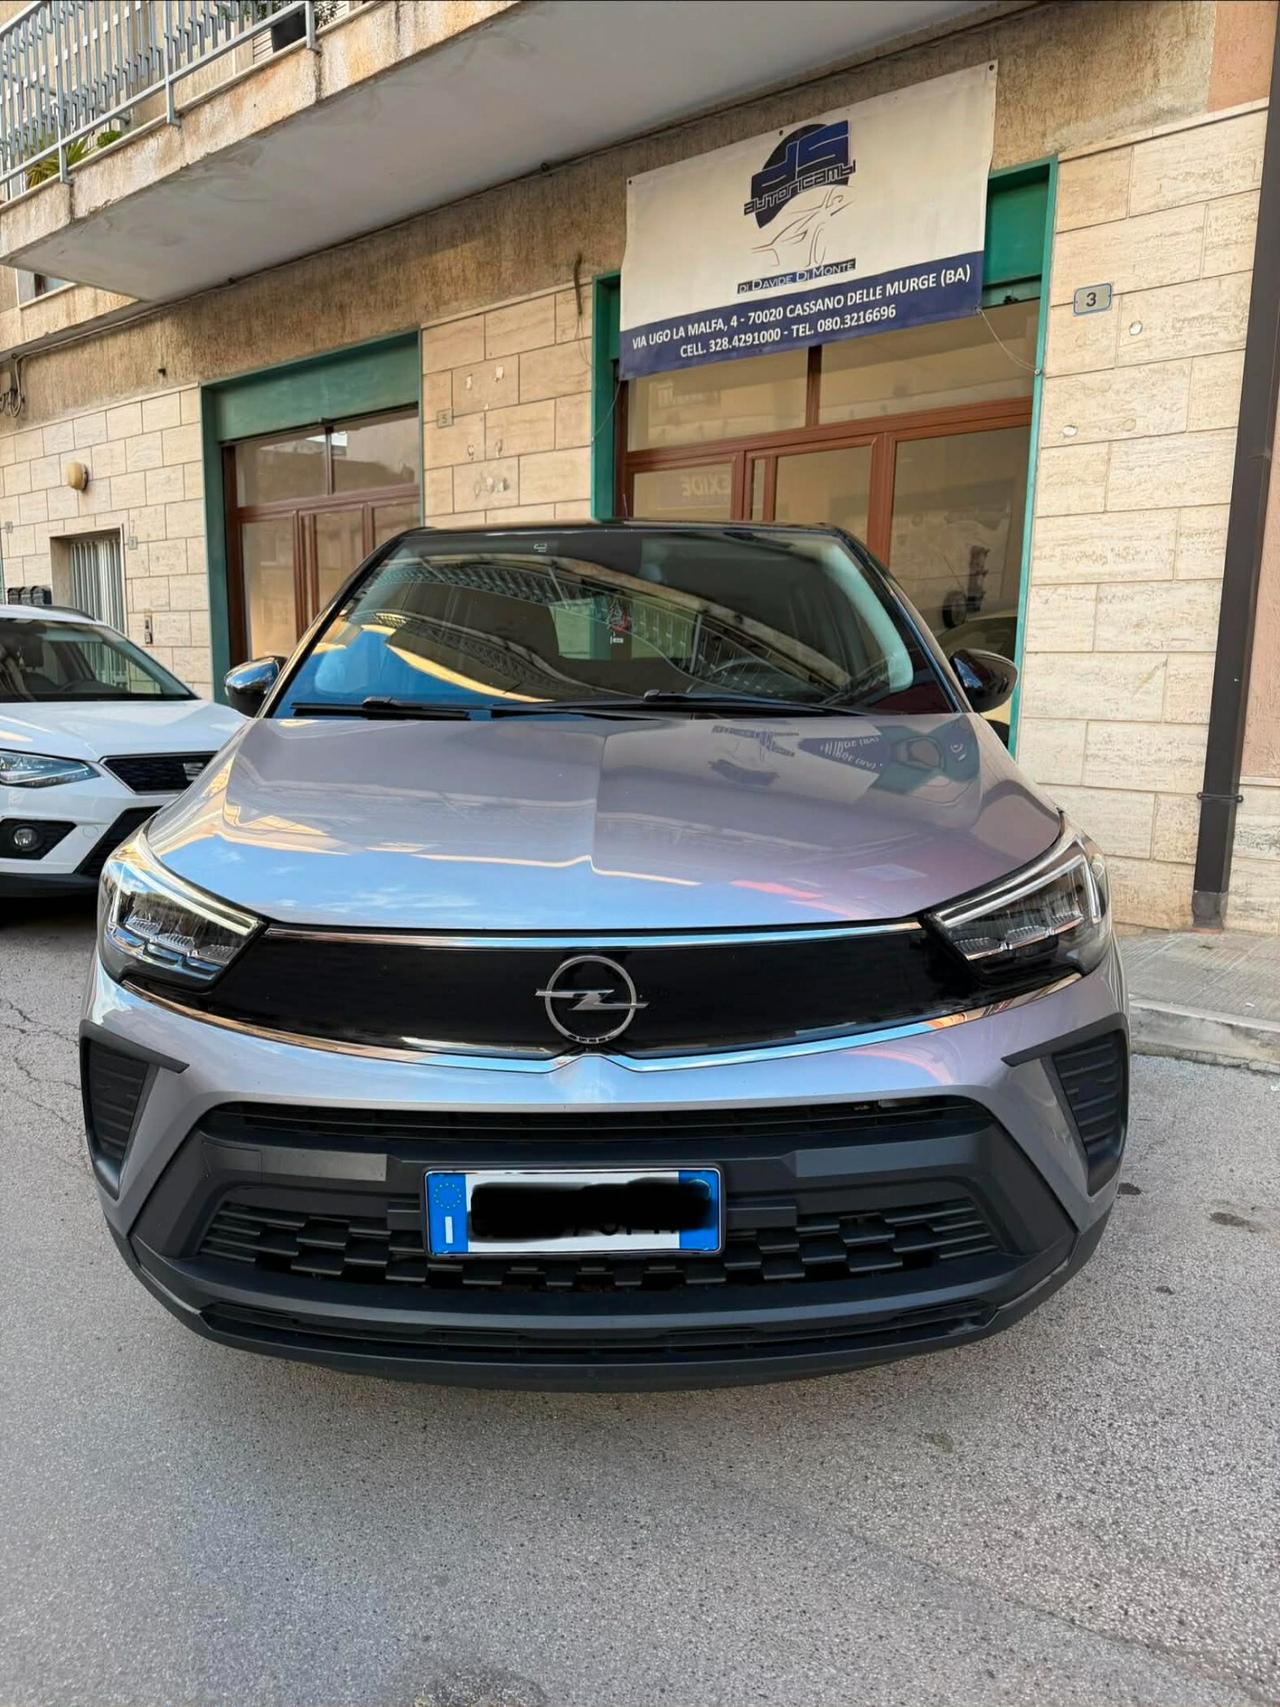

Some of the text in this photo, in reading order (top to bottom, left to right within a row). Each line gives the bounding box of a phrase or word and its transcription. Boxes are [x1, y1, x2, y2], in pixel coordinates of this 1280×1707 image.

[632, 336, 647, 350] VIA
[650, 329, 671, 345] UGO
[673, 326, 685, 340] LA
[688, 318, 728, 337] MALFA,
[730, 315, 738, 328] 4
[748, 306, 783, 325] 70020
[786, 294, 844, 318] CASSANO
[847, 285, 883, 306] DELLE
[886, 273, 937, 297] MURGE
[940, 263, 971, 288] (BA)
[1085, 291, 1097, 307] 3
[680, 342, 707, 358] CELL.
[709, 327, 781, 352] 328.4291000
[791, 322, 814, 339] TEL.
[817, 304, 896, 333] 080.3216696
[445, 1216, 453, 1244] I
